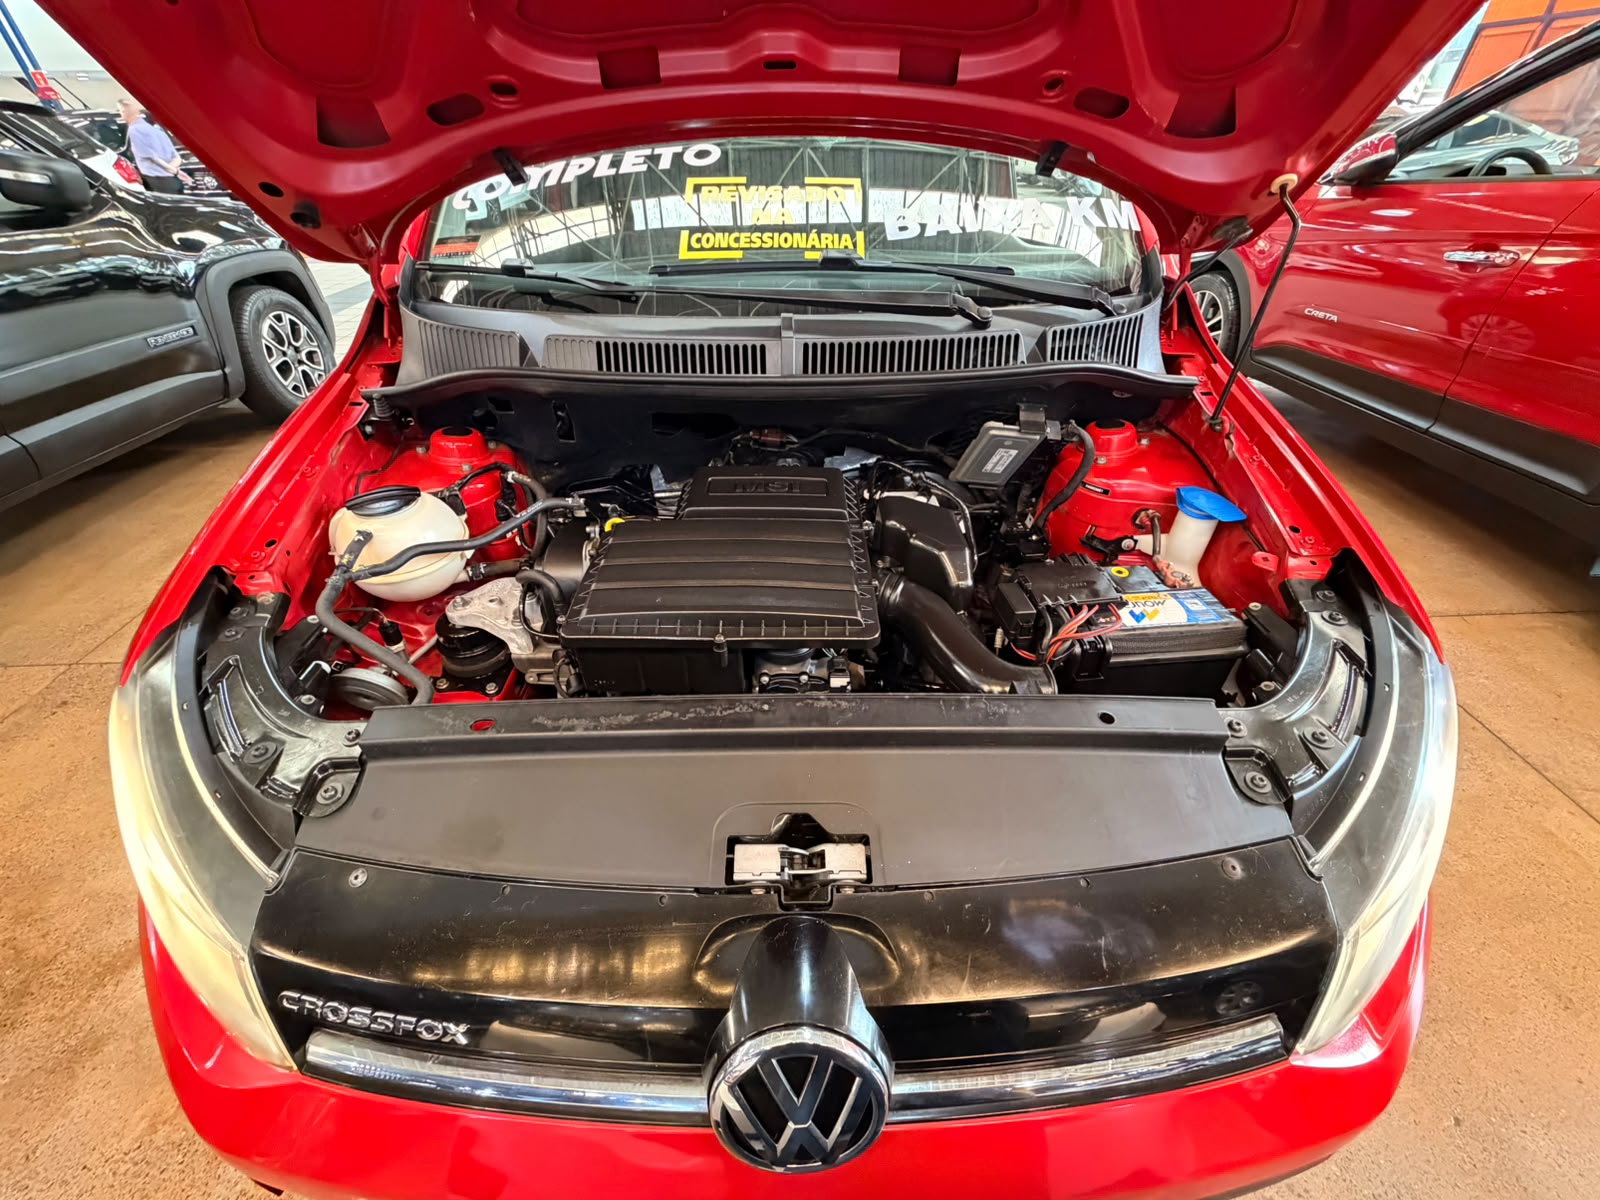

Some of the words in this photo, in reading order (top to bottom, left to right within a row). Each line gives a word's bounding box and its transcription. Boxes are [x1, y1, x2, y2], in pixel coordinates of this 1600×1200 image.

[700, 185, 847, 204] REVISADO
[751, 208, 794, 226] NA
[1066, 196, 1142, 232] KM
[690, 229, 854, 250] CONCESSIONÁRIA
[1303, 307, 1338, 323] CRETA
[278, 990, 470, 1045] CROSSFOX
